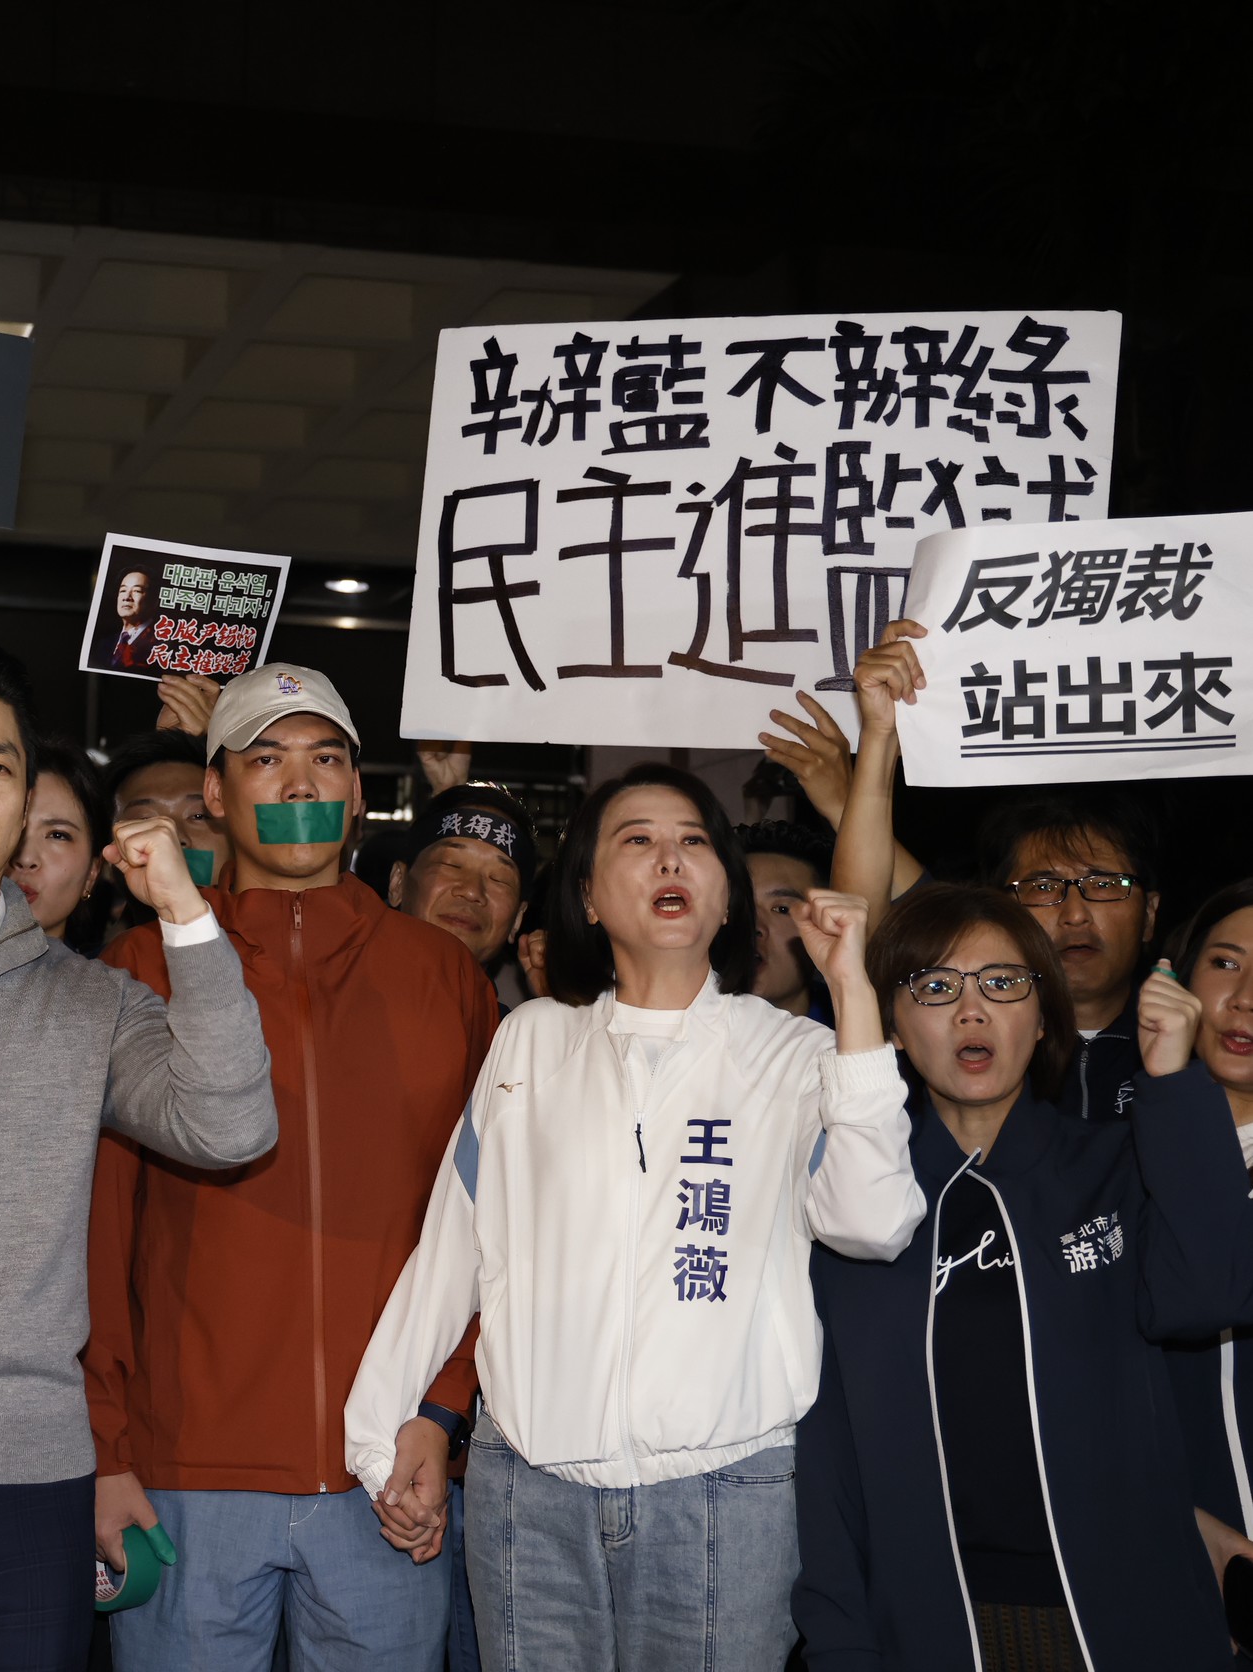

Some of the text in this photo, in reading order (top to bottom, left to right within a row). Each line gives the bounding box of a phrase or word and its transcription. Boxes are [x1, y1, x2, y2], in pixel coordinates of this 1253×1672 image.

[460, 315, 1092, 456] 辦藍不辦綠
[158, 587, 271, 619] 민주의 파괴자!
[162, 563, 273, 597] 대만판 윤석열,
[941, 543, 1214, 633] 反獨裁
[960, 652, 1236, 740] 站出來
[672, 1118, 733, 1303] 王鴻薇
